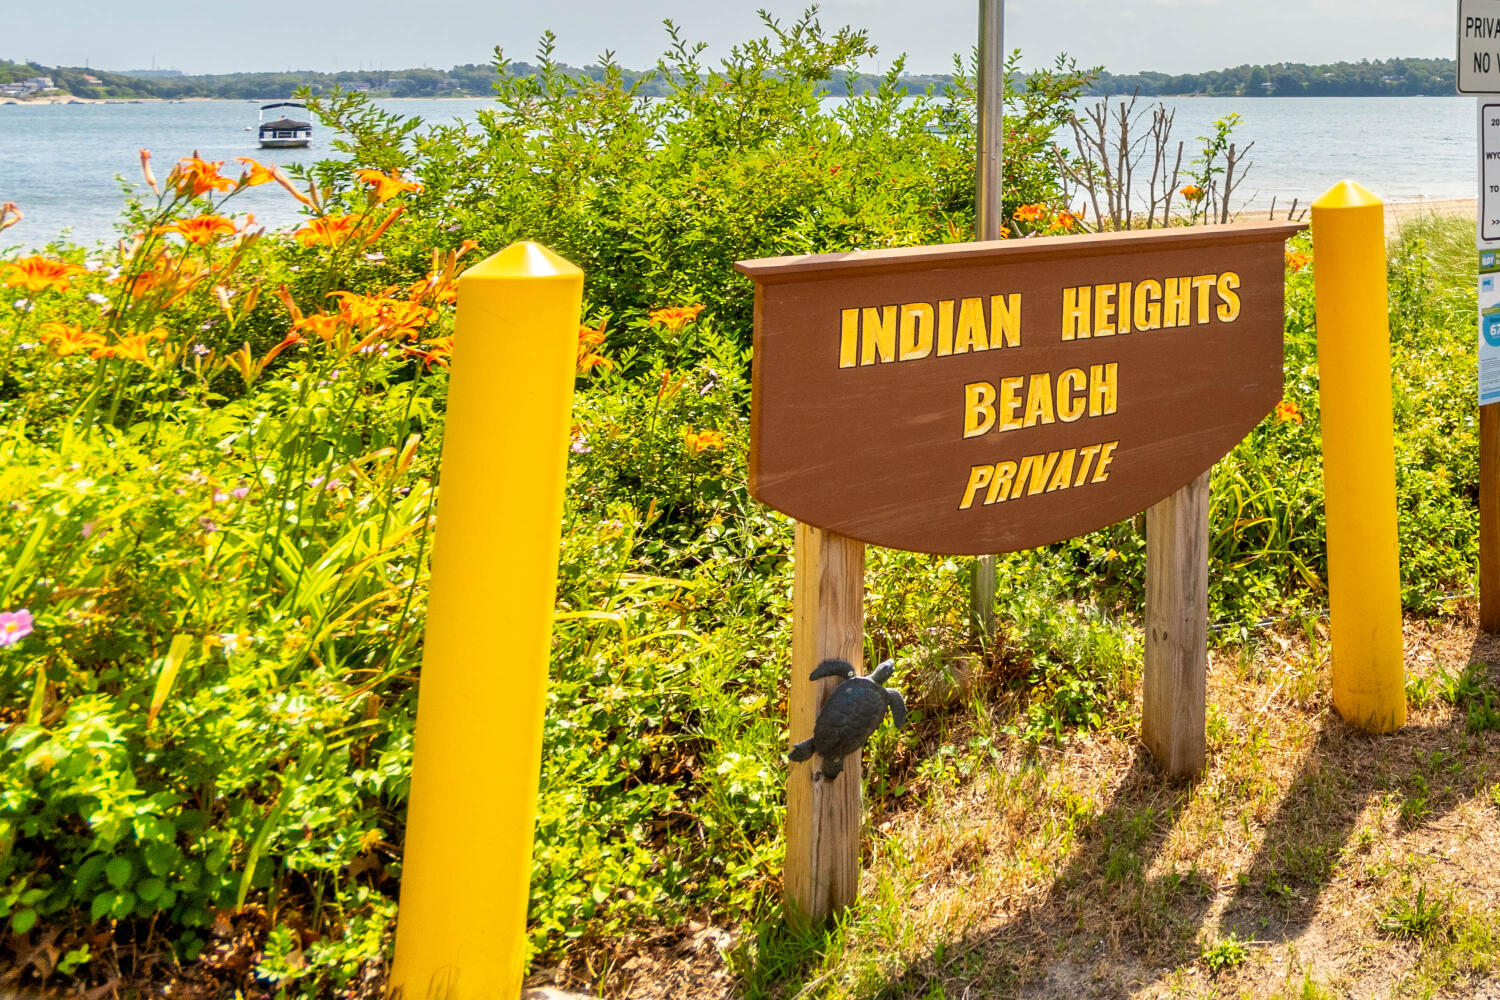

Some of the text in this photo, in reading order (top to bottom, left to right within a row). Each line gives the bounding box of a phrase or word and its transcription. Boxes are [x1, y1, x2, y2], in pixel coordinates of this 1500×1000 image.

[1474, 52, 1490, 73] NO
[838, 271, 1241, 369] INDIAN HEIGHTS
[963, 362, 1118, 439] BEACH
[958, 440, 1119, 510] PRIVATE
